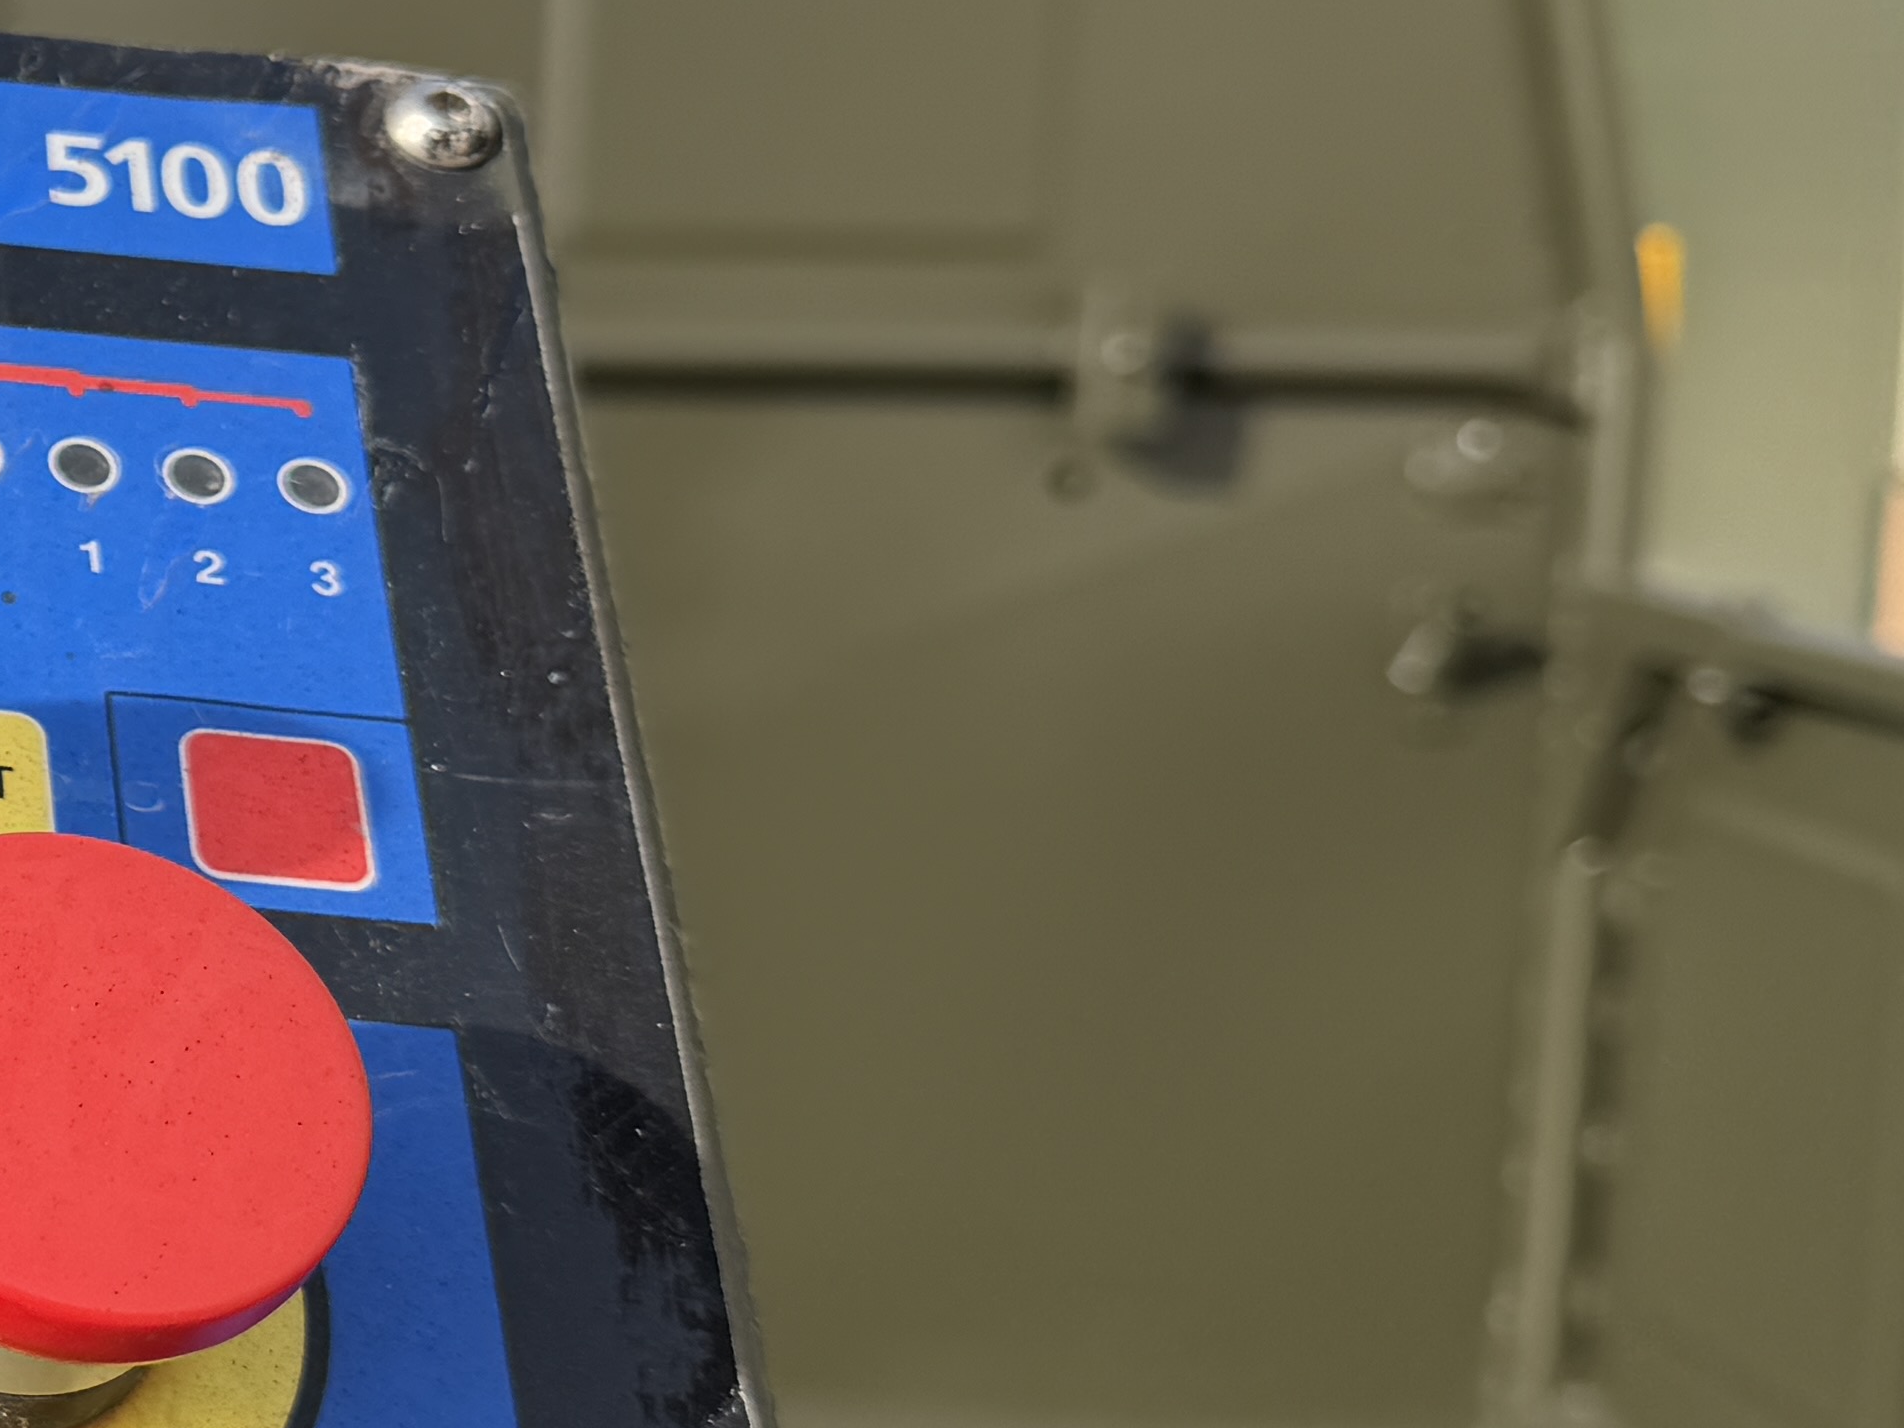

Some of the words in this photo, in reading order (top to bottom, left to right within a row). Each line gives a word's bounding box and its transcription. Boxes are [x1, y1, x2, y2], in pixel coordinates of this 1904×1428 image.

[45, 131, 308, 226] 5100
[79, 540, 103, 574] 1
[193, 549, 227, 586] 2
[309, 560, 344, 597] 3
